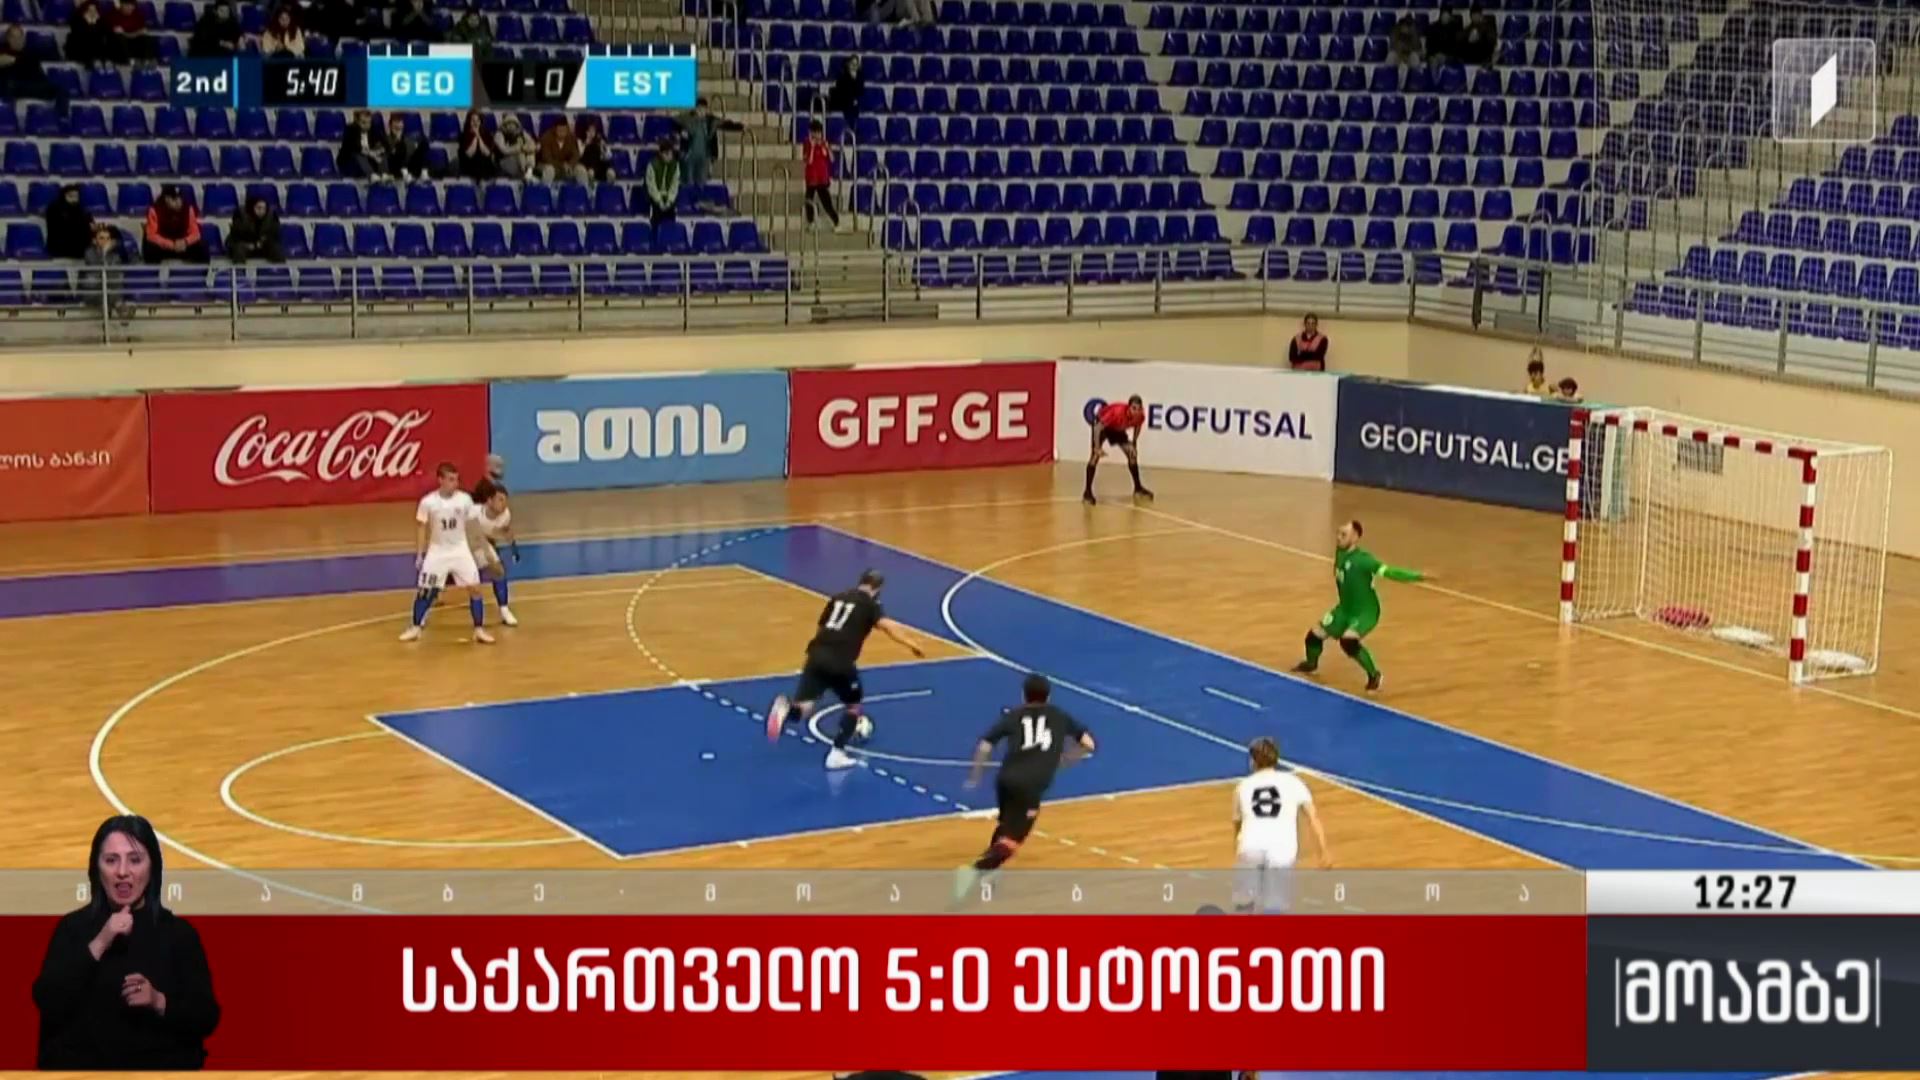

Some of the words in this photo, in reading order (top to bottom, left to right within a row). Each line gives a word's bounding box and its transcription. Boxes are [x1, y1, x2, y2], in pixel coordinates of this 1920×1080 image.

[817, 391, 1030, 449] GFF.GE
[1146, 402, 1313, 442] EOFUTSAL
[49, 451, 111, 468] ბანკი
[214, 408, 433, 486] Coca-Cola
[1360, 421, 1569, 475] GEOFUTSAL.GE
[1021, 715, 1053, 752] 14
[1251, 786, 1282, 818] 8
